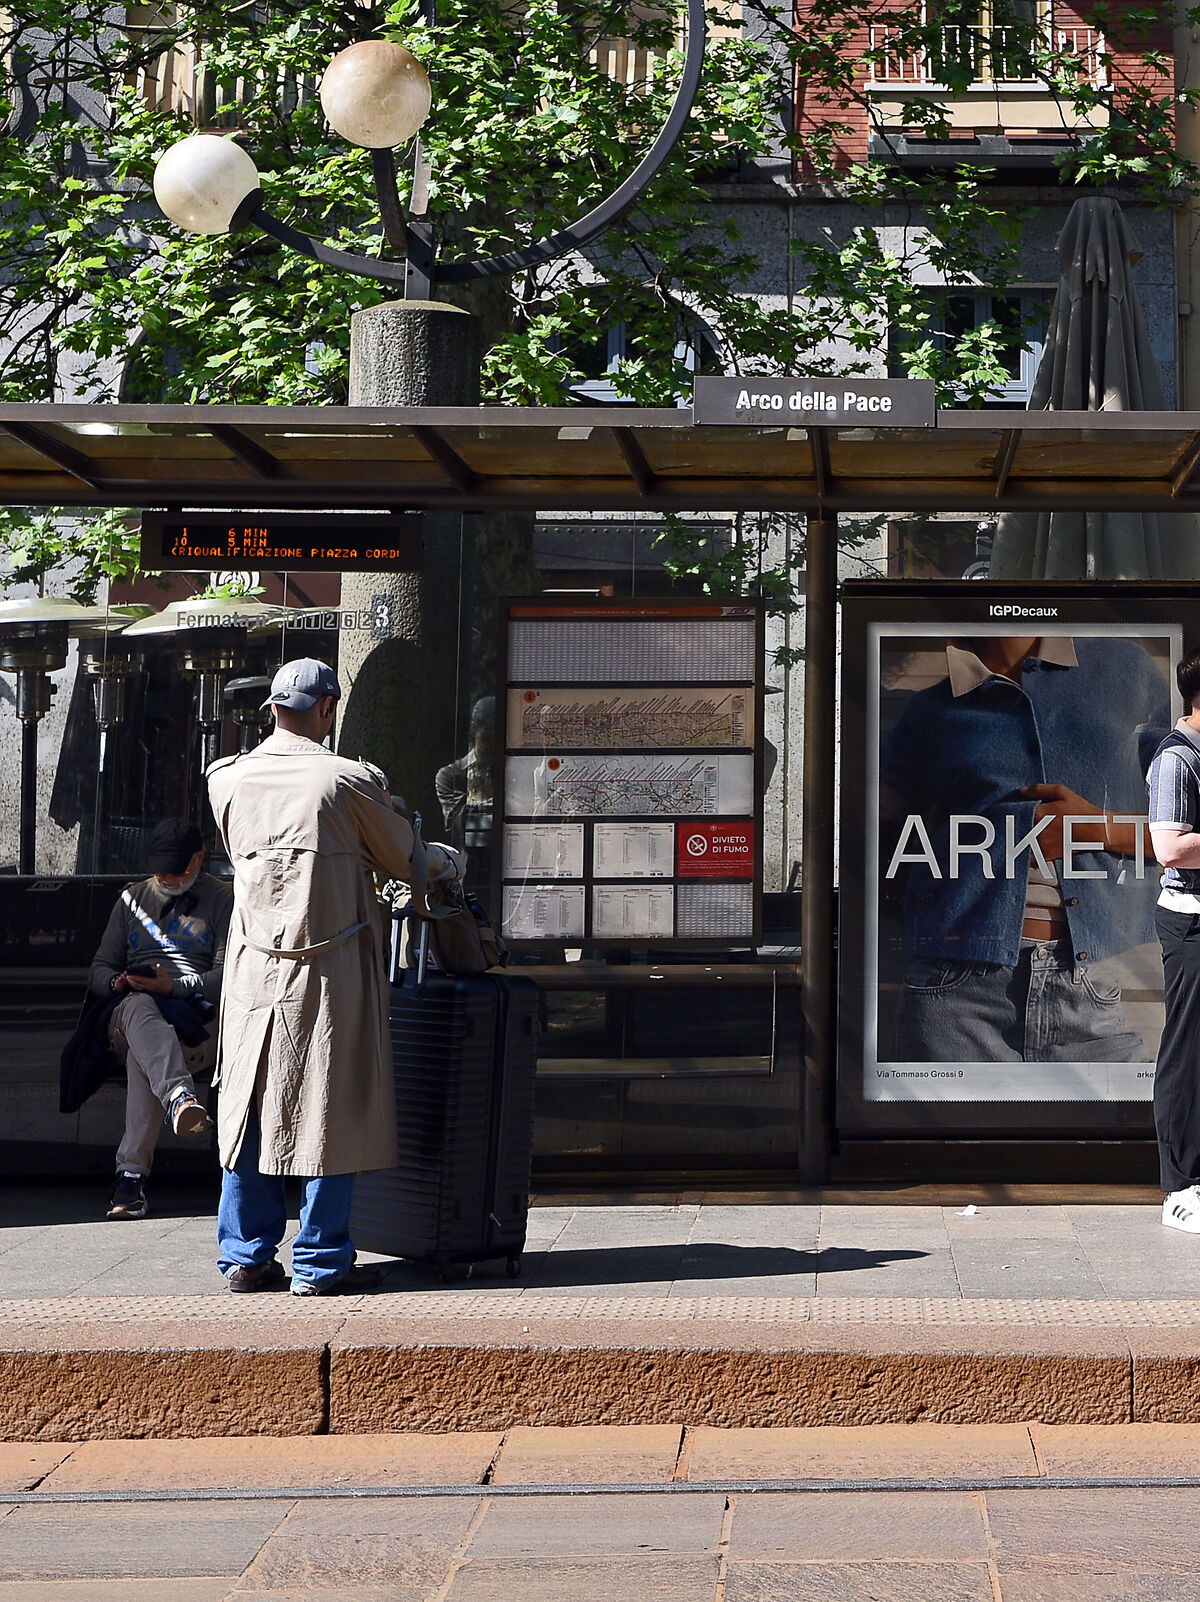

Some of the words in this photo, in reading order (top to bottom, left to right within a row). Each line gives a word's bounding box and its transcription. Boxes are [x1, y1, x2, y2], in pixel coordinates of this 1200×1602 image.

[735, 389, 783, 410] Arco
[789, 391, 837, 411] della
[843, 391, 892, 412] Pace
[183, 527, 188, 537] 1
[228, 527, 236, 537] 6
[244, 528, 267, 537] MIN
[175, 537, 188, 546] 10
[227, 537, 236, 547] 5
[243, 537, 267, 547] MIN
[311, 548, 358, 558] PIAZZA
[989, 605, 1058, 616] IGPDecaux
[177, 611, 249, 628] Fermata
[375, 604, 389, 628] 3
[712, 835, 747, 844] DIVIETO
[712, 845, 722, 853] DI
[723, 845, 749, 853] FUMO
[885, 814, 1150, 880] ARKET
[876, 1070, 889, 1078] Via
[891, 1070, 929, 1078] Tommaso
[930, 1070, 957, 1078] Grossi
[958, 1070, 964, 1078] 9
